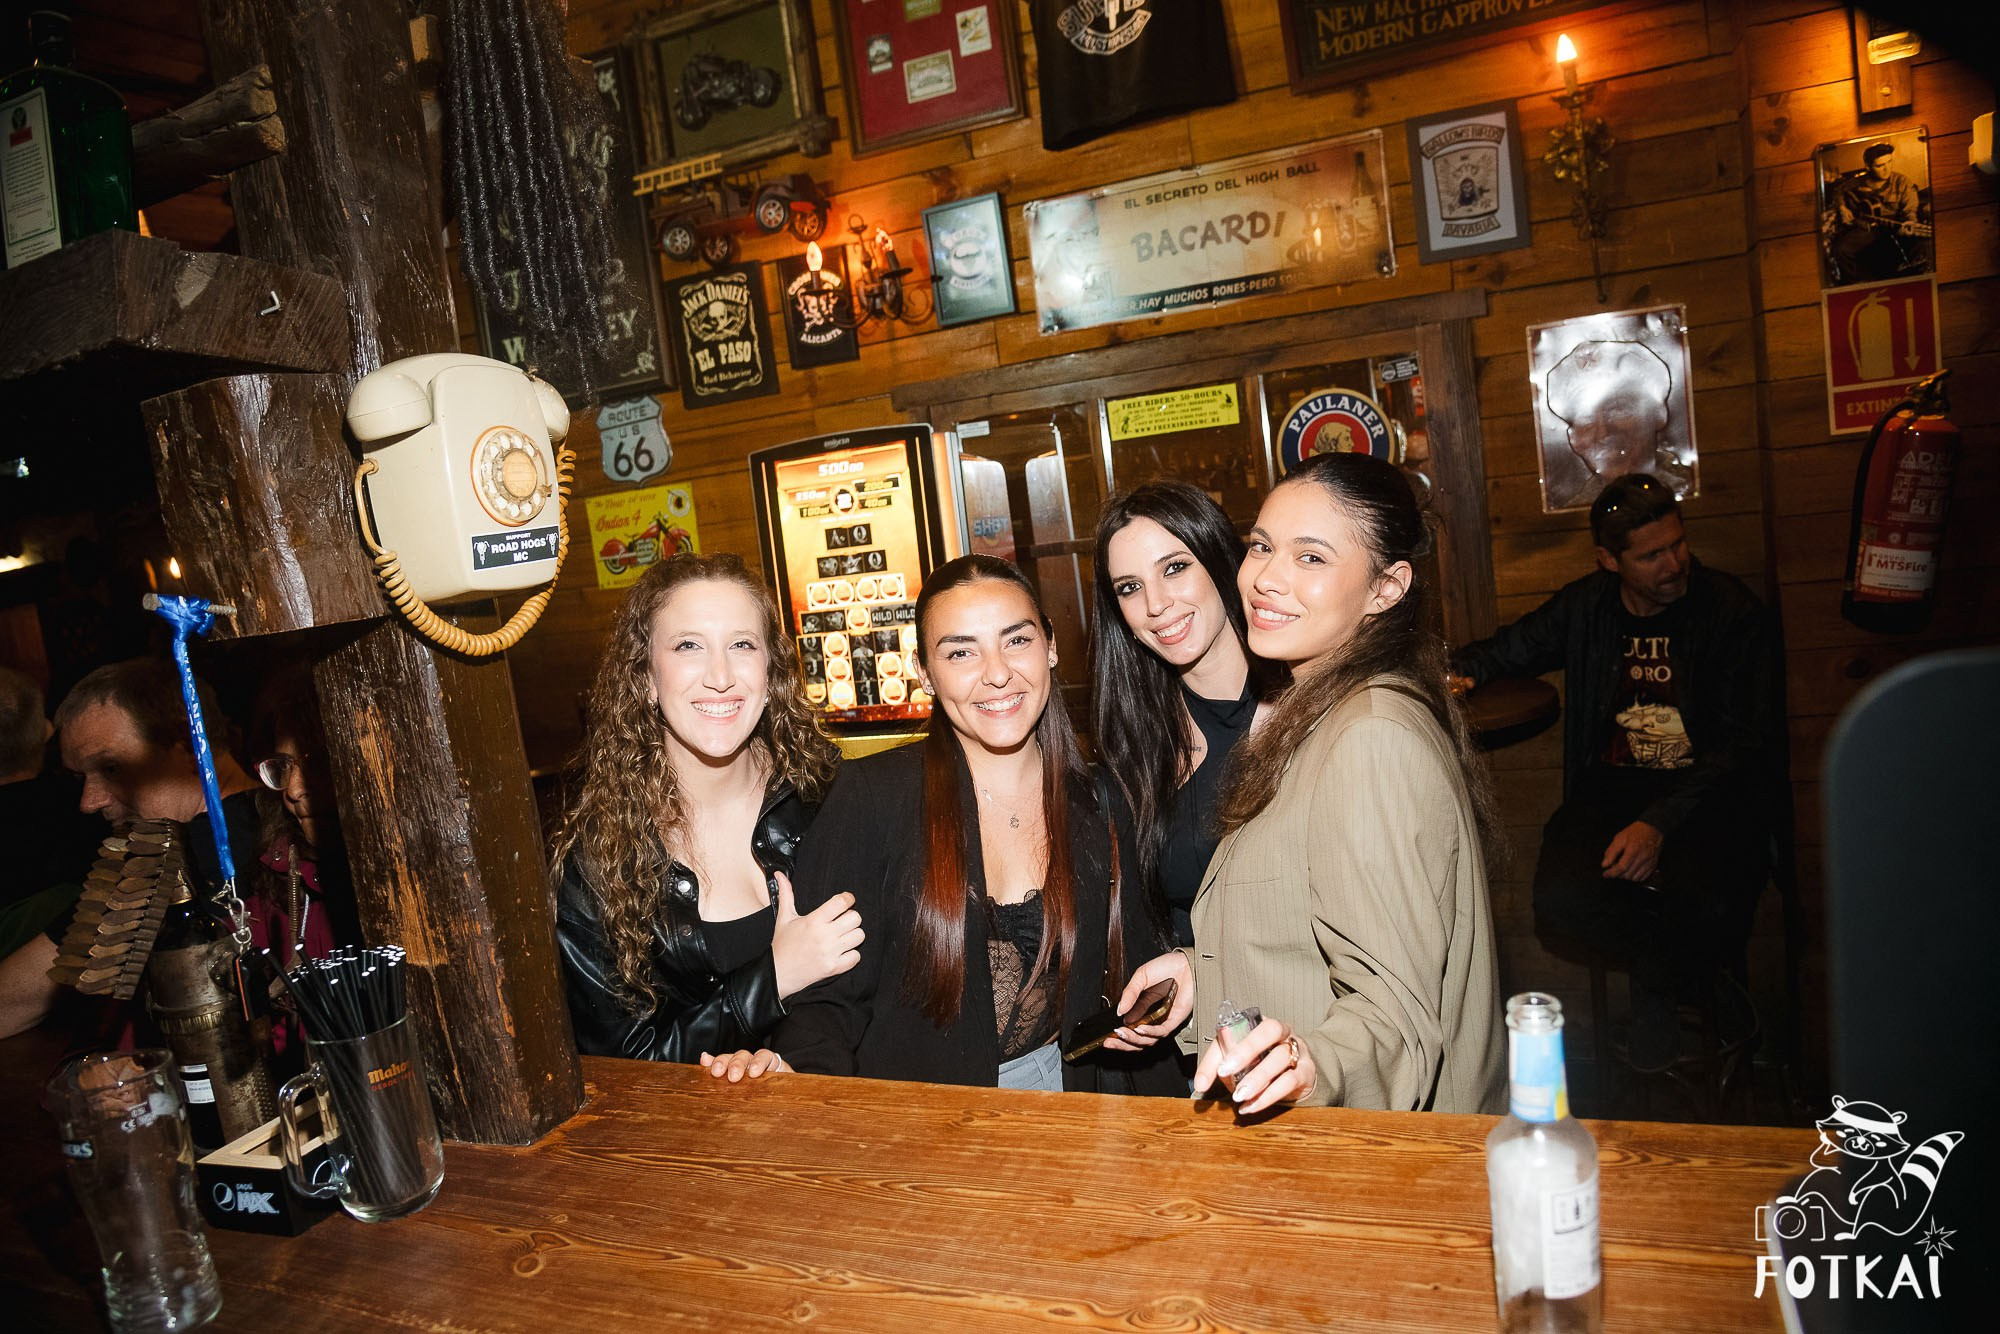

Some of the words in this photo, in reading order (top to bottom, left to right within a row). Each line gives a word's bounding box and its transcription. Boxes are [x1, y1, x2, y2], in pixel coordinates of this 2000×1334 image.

[1315, 6, 1367, 38] NEW
[1320, 17, 1414, 60] MODERN
[1124, 199, 1140, 210] EL
[1146, 184, 1208, 205] SECRETO
[1215, 178, 1240, 192] DEL
[1246, 170, 1279, 186] HIGH
[1286, 162, 1320, 178] BALL
[1131, 211, 1286, 262] BACARDI
[681, 289, 708, 318] JACK
[1140, 297, 1161, 310] HAY
[1164, 288, 1208, 305] MUCHOS
[695, 349, 715, 372] EL
[718, 341, 752, 365] PASO
[608, 406, 648, 422] ROUTE
[1122, 401, 1142, 411] FREE
[1288, 394, 1386, 440] PAULANER
[614, 437, 655, 477] 66
[491, 541, 519, 554] ROAD
[521, 537, 546, 550] HOGS
[506, 532, 532, 541] SUPPORT
[513, 551, 529, 563] MC
[1876, 559, 1928, 572] MTSFire
[871, 609, 893, 622] WILD
